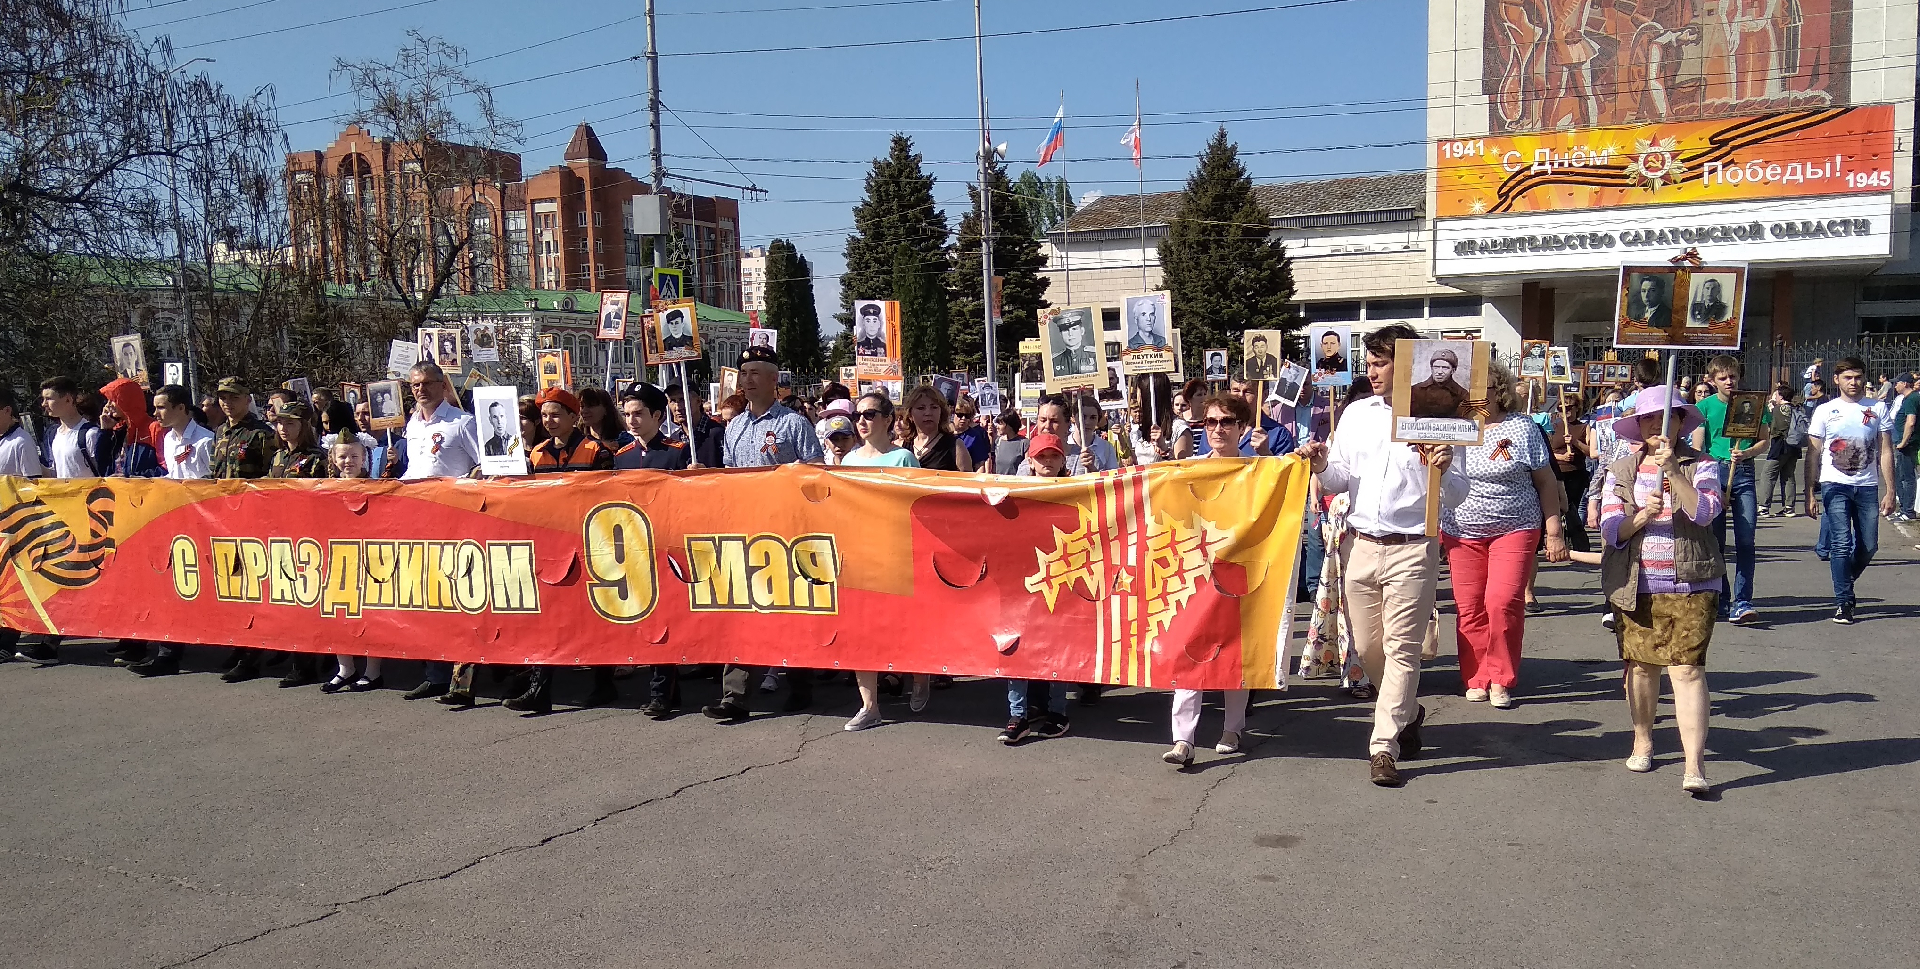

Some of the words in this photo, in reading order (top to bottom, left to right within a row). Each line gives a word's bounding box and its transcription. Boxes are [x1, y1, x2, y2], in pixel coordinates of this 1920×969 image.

[1442, 140, 1484, 159] 1941
[1503, 151, 1522, 172] С
[1531, 146, 1608, 175] Днём
[1703, 154, 1843, 186] Победы!
[1846, 171, 1891, 188] 1945
[1453, 232, 1616, 256] ПРАВИТЕЛЬСТВО
[1619, 220, 1766, 247] САРАТОВСКОЙ
[1770, 218, 1871, 239] ОБЛАСТИ
[171, 534, 200, 601] С
[210, 536, 541, 618] ПРАЗДНИКОМ
[583, 500, 659, 624] 9
